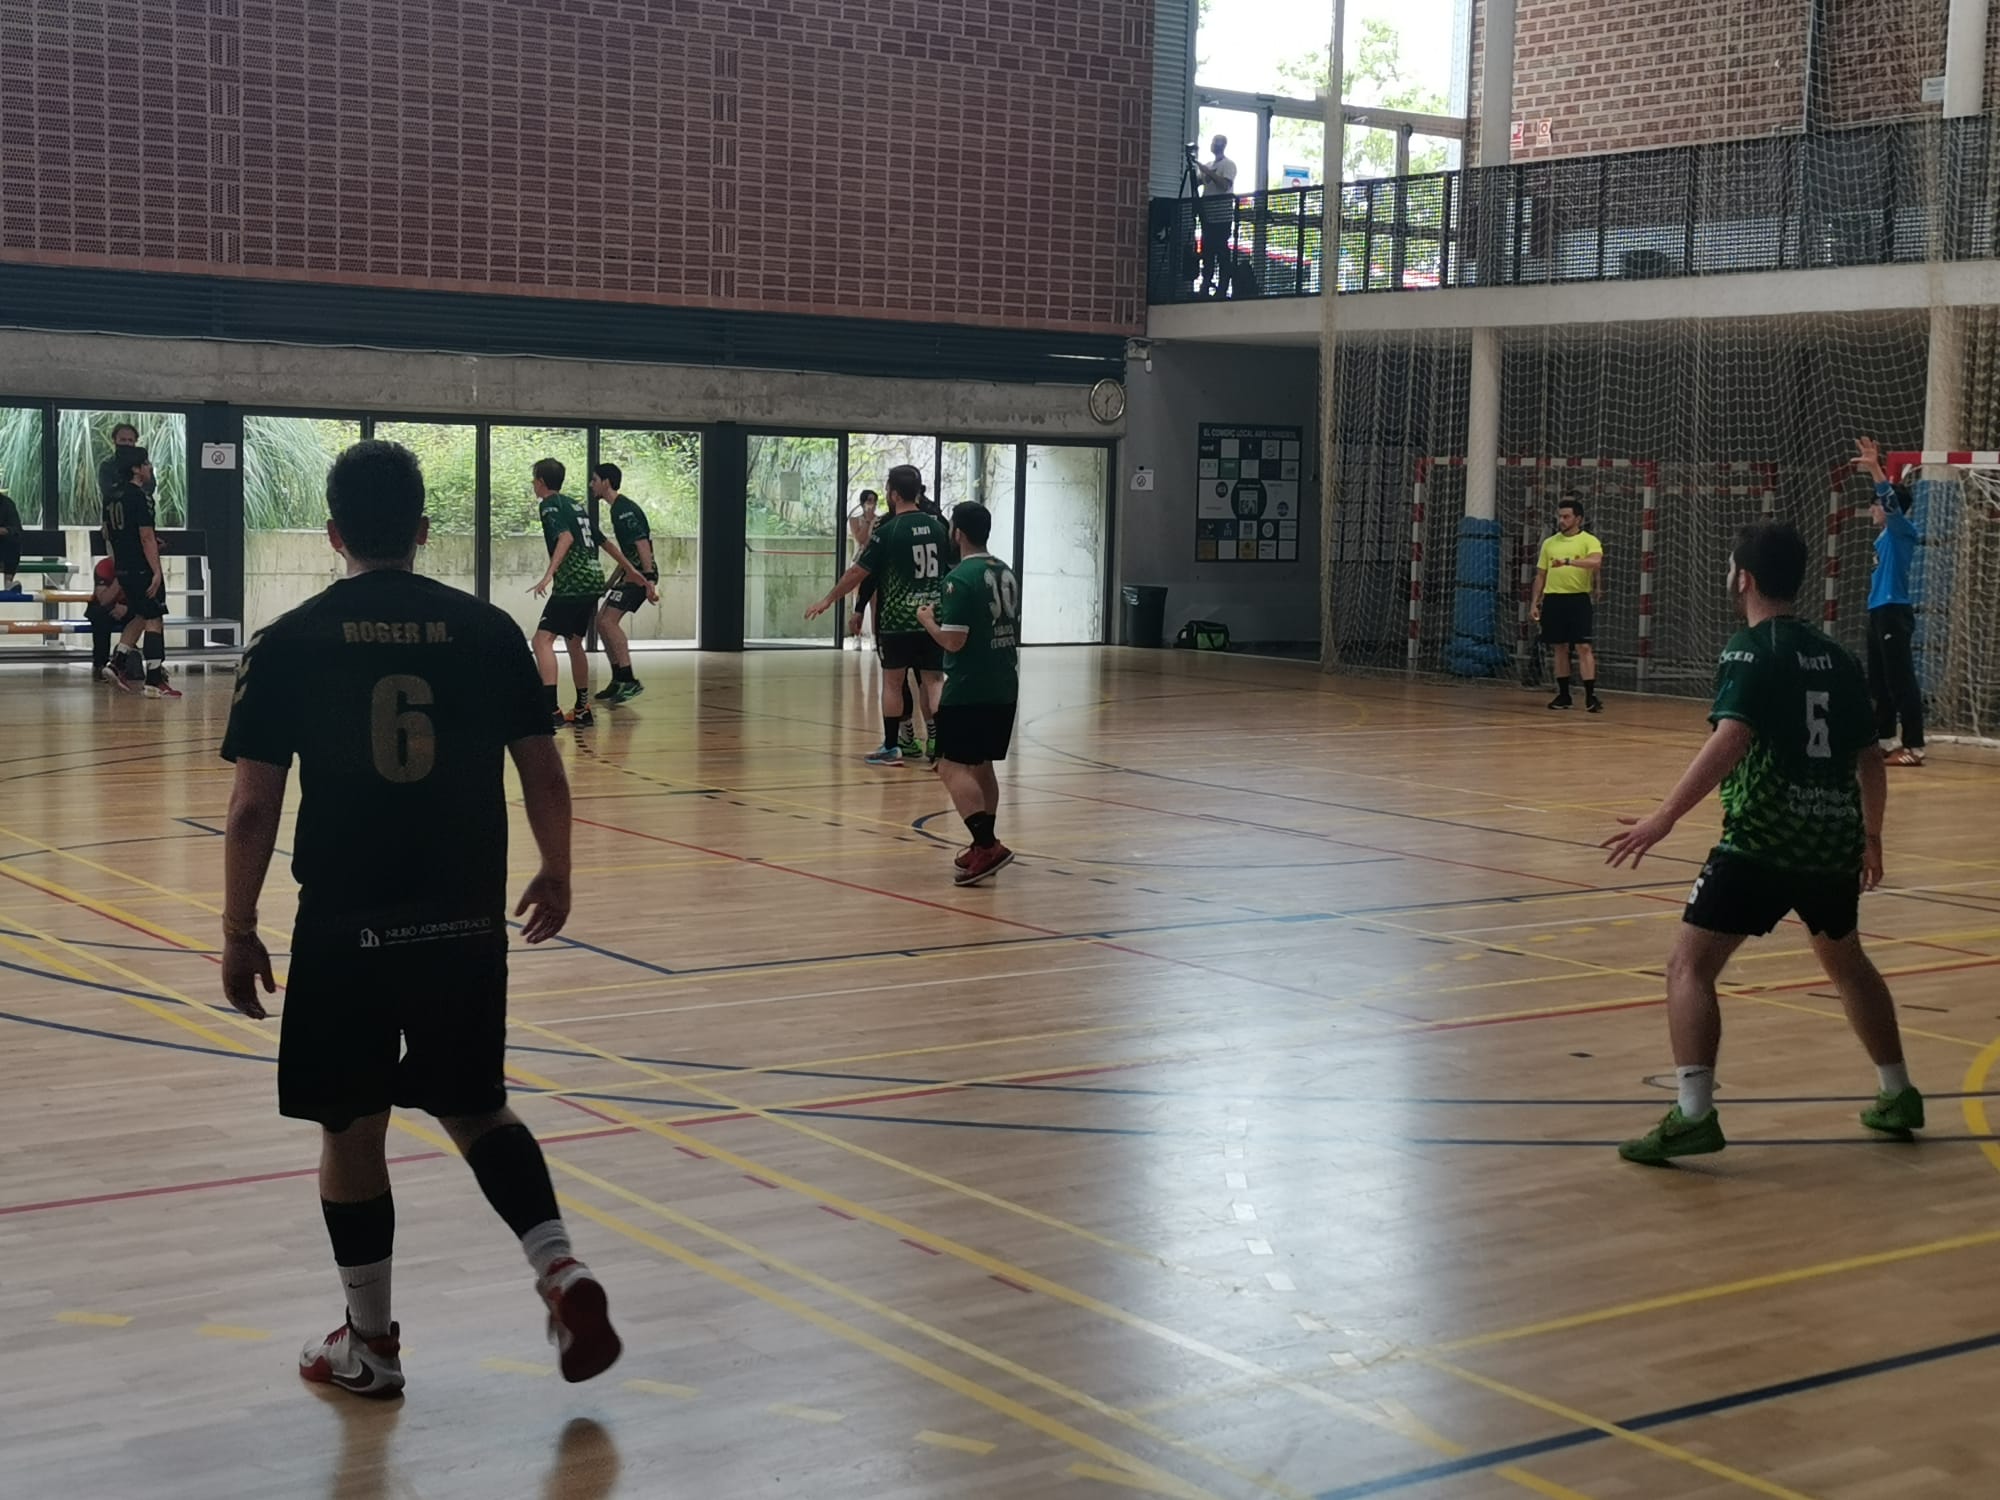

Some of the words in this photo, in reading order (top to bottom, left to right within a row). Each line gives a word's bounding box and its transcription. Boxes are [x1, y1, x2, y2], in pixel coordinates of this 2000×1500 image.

[911, 543, 939, 579] 96
[342, 621, 421, 643] ROGER
[425, 621, 454, 643] M.
[371, 674, 436, 783] 6
[1805, 690, 1832, 758] 6
